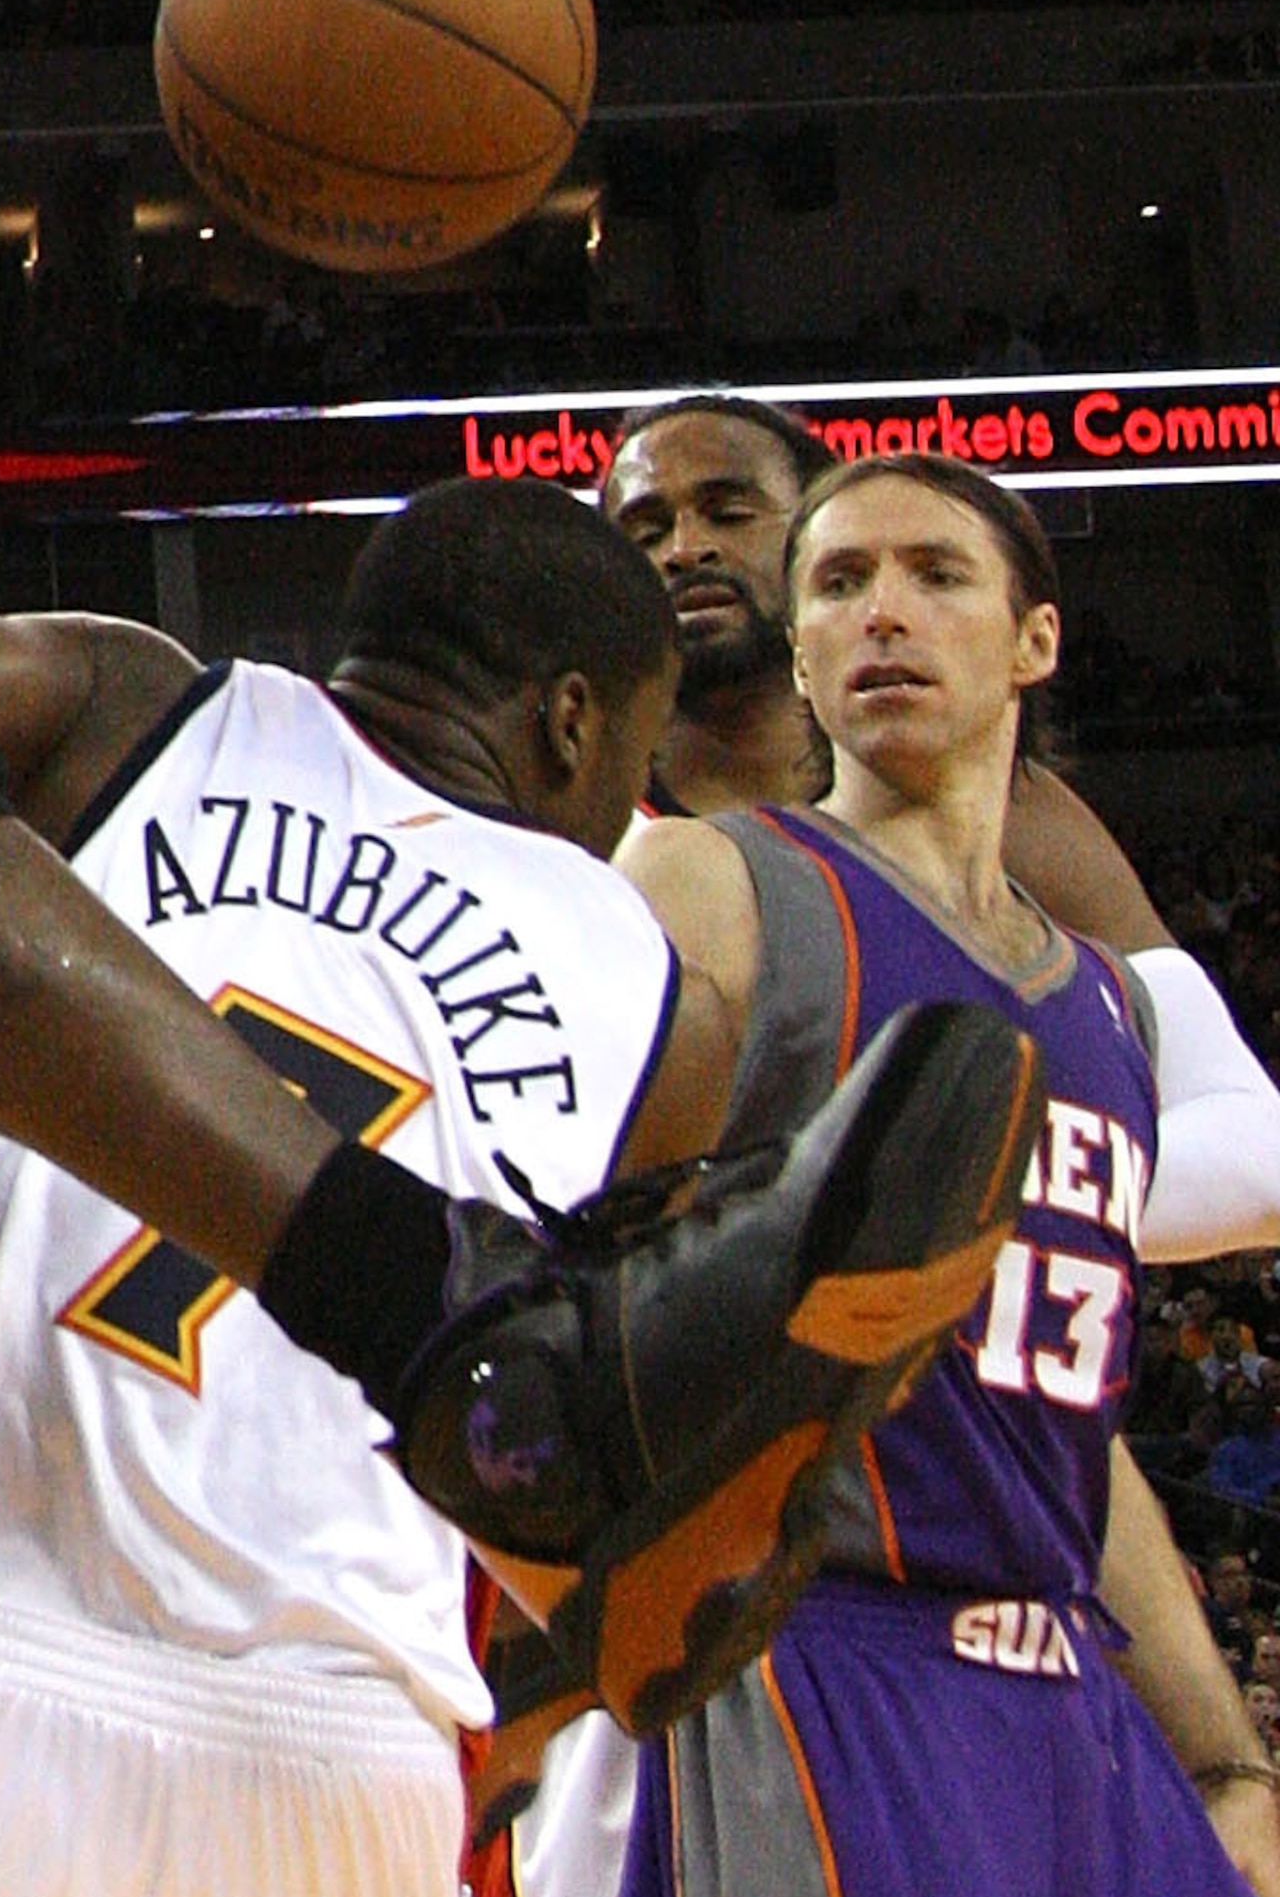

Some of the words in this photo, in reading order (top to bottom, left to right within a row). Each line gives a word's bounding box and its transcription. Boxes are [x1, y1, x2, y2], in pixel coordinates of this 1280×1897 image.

[806, 396, 1054, 464] markets
[142, 795, 578, 1124] AZUBUIKE
[976, 1240, 1128, 1410] 13
